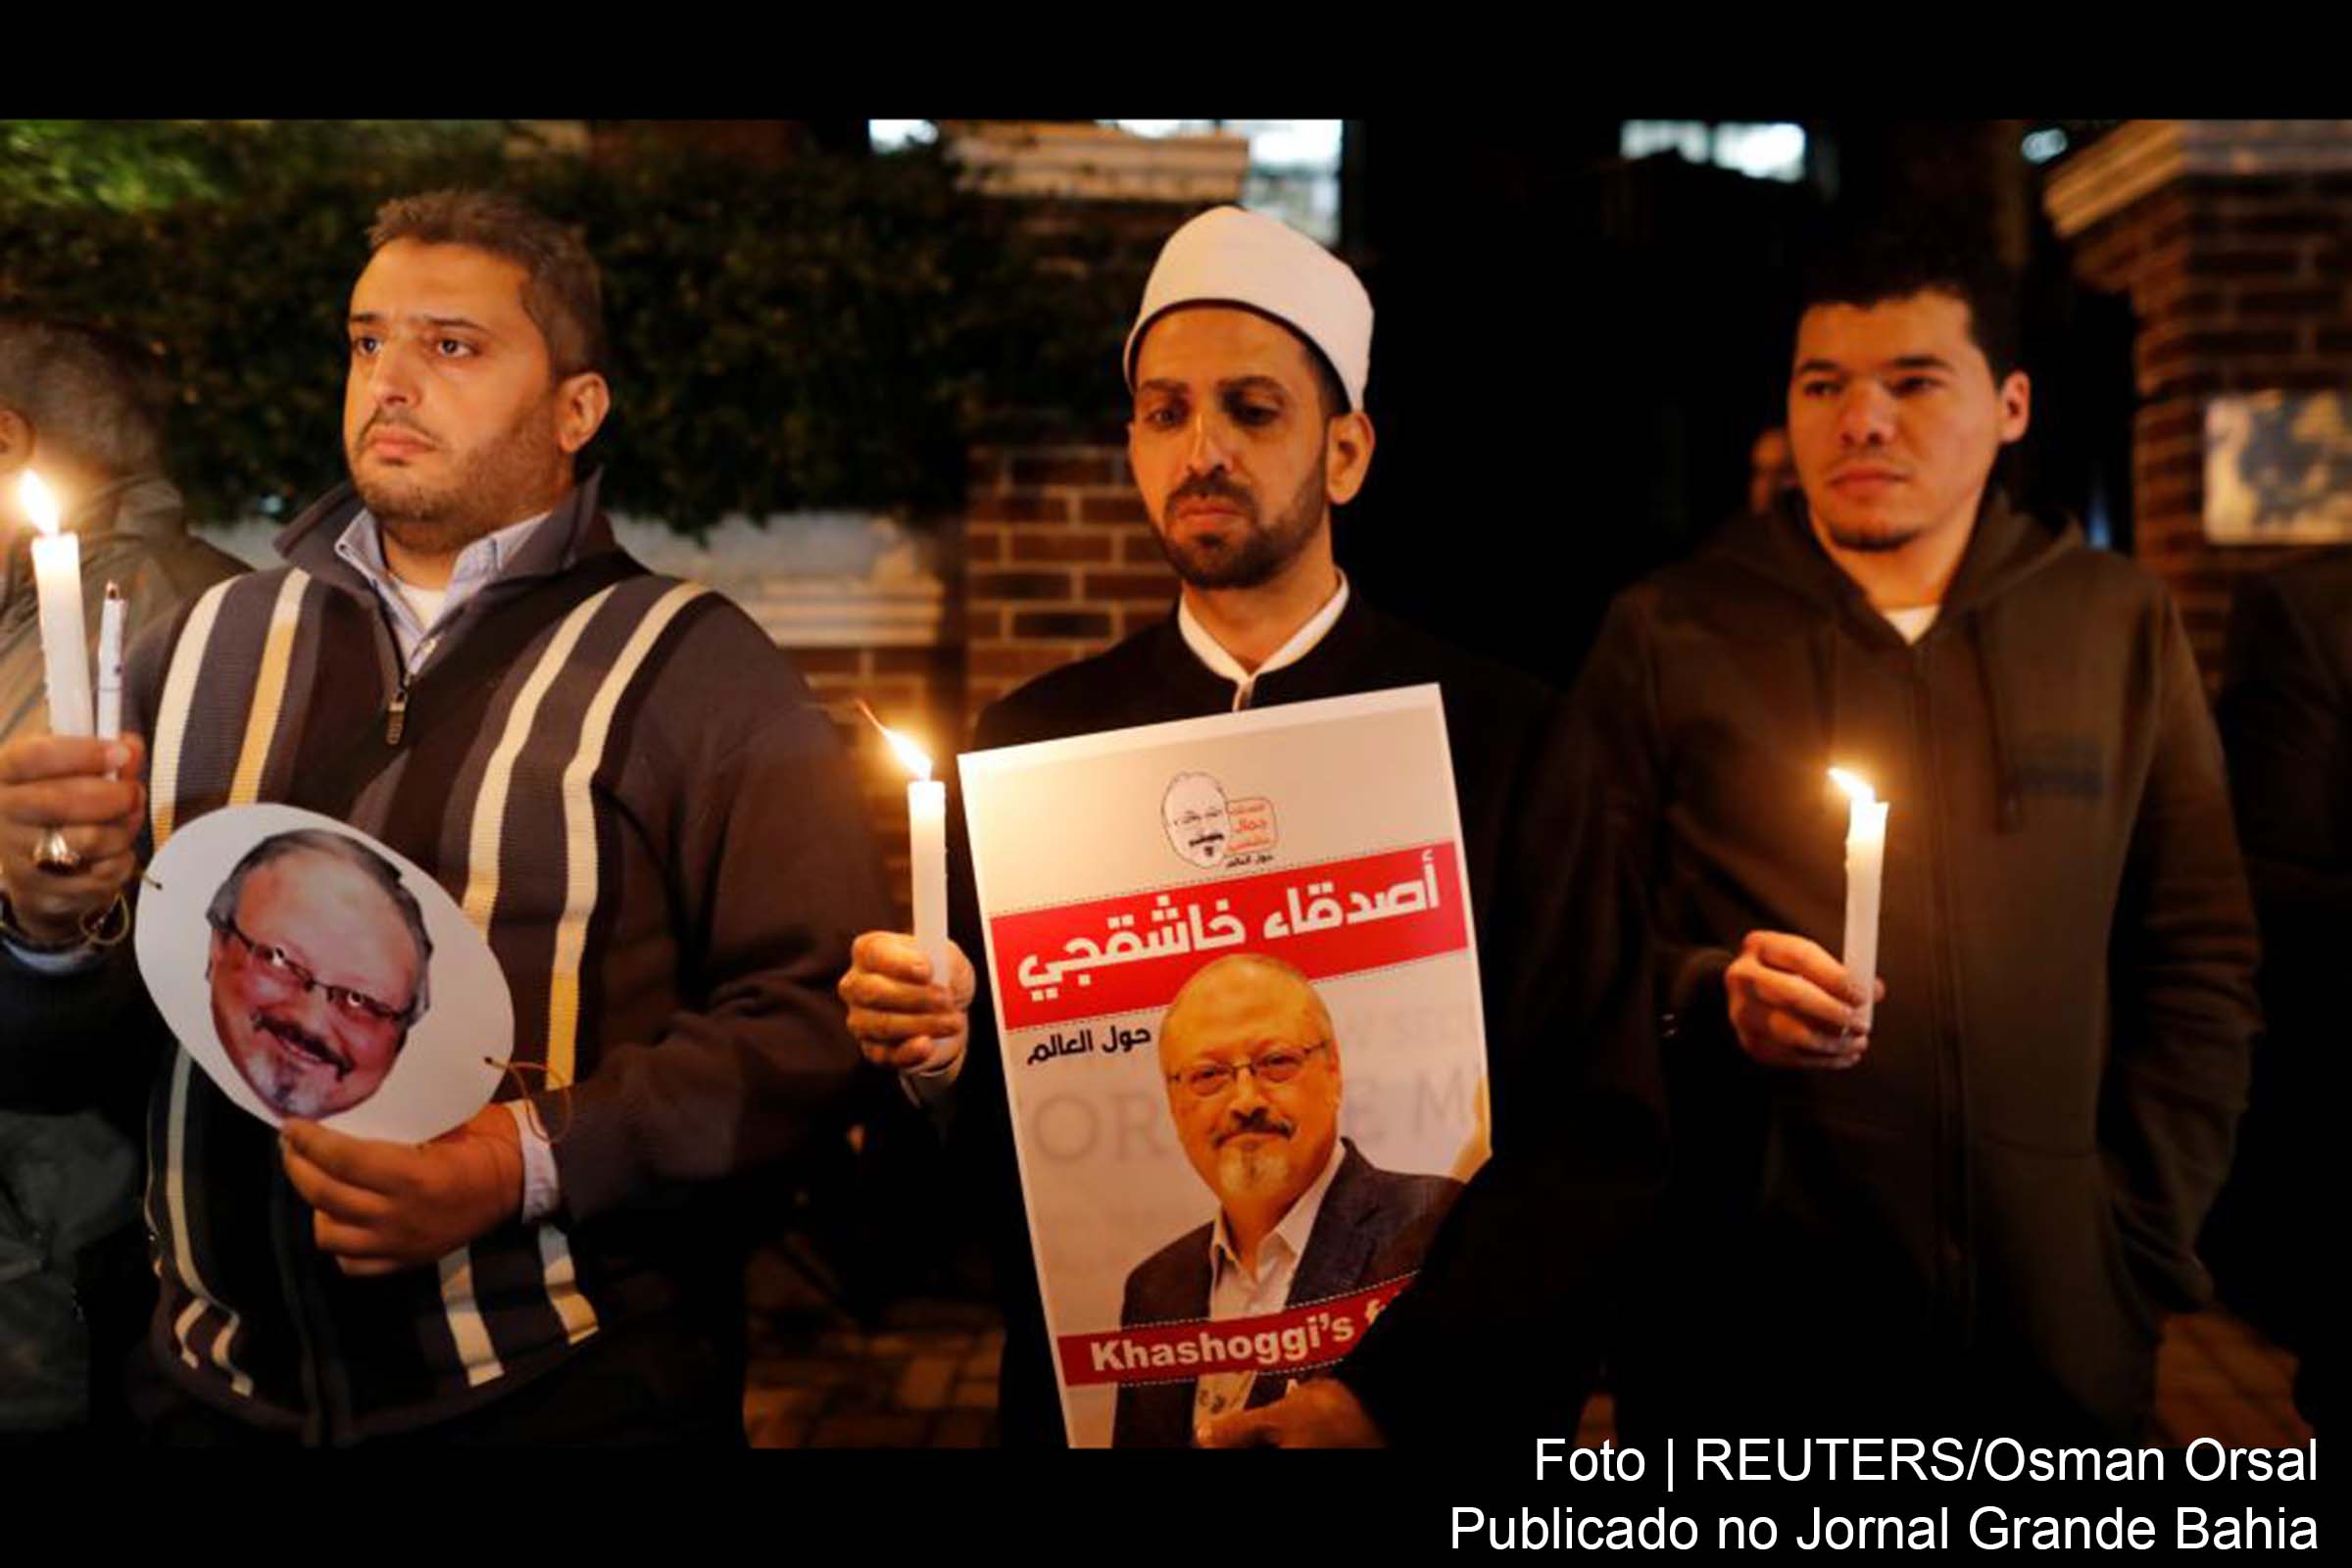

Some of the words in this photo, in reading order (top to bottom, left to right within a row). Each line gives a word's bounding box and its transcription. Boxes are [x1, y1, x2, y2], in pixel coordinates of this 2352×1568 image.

[1262, 849, 1441, 941] أصدقاء
[1017, 895, 1247, 1003] خاشقجي
[1026, 1029, 1095, 1066] العالم
[1101, 1024, 1152, 1054] حول
